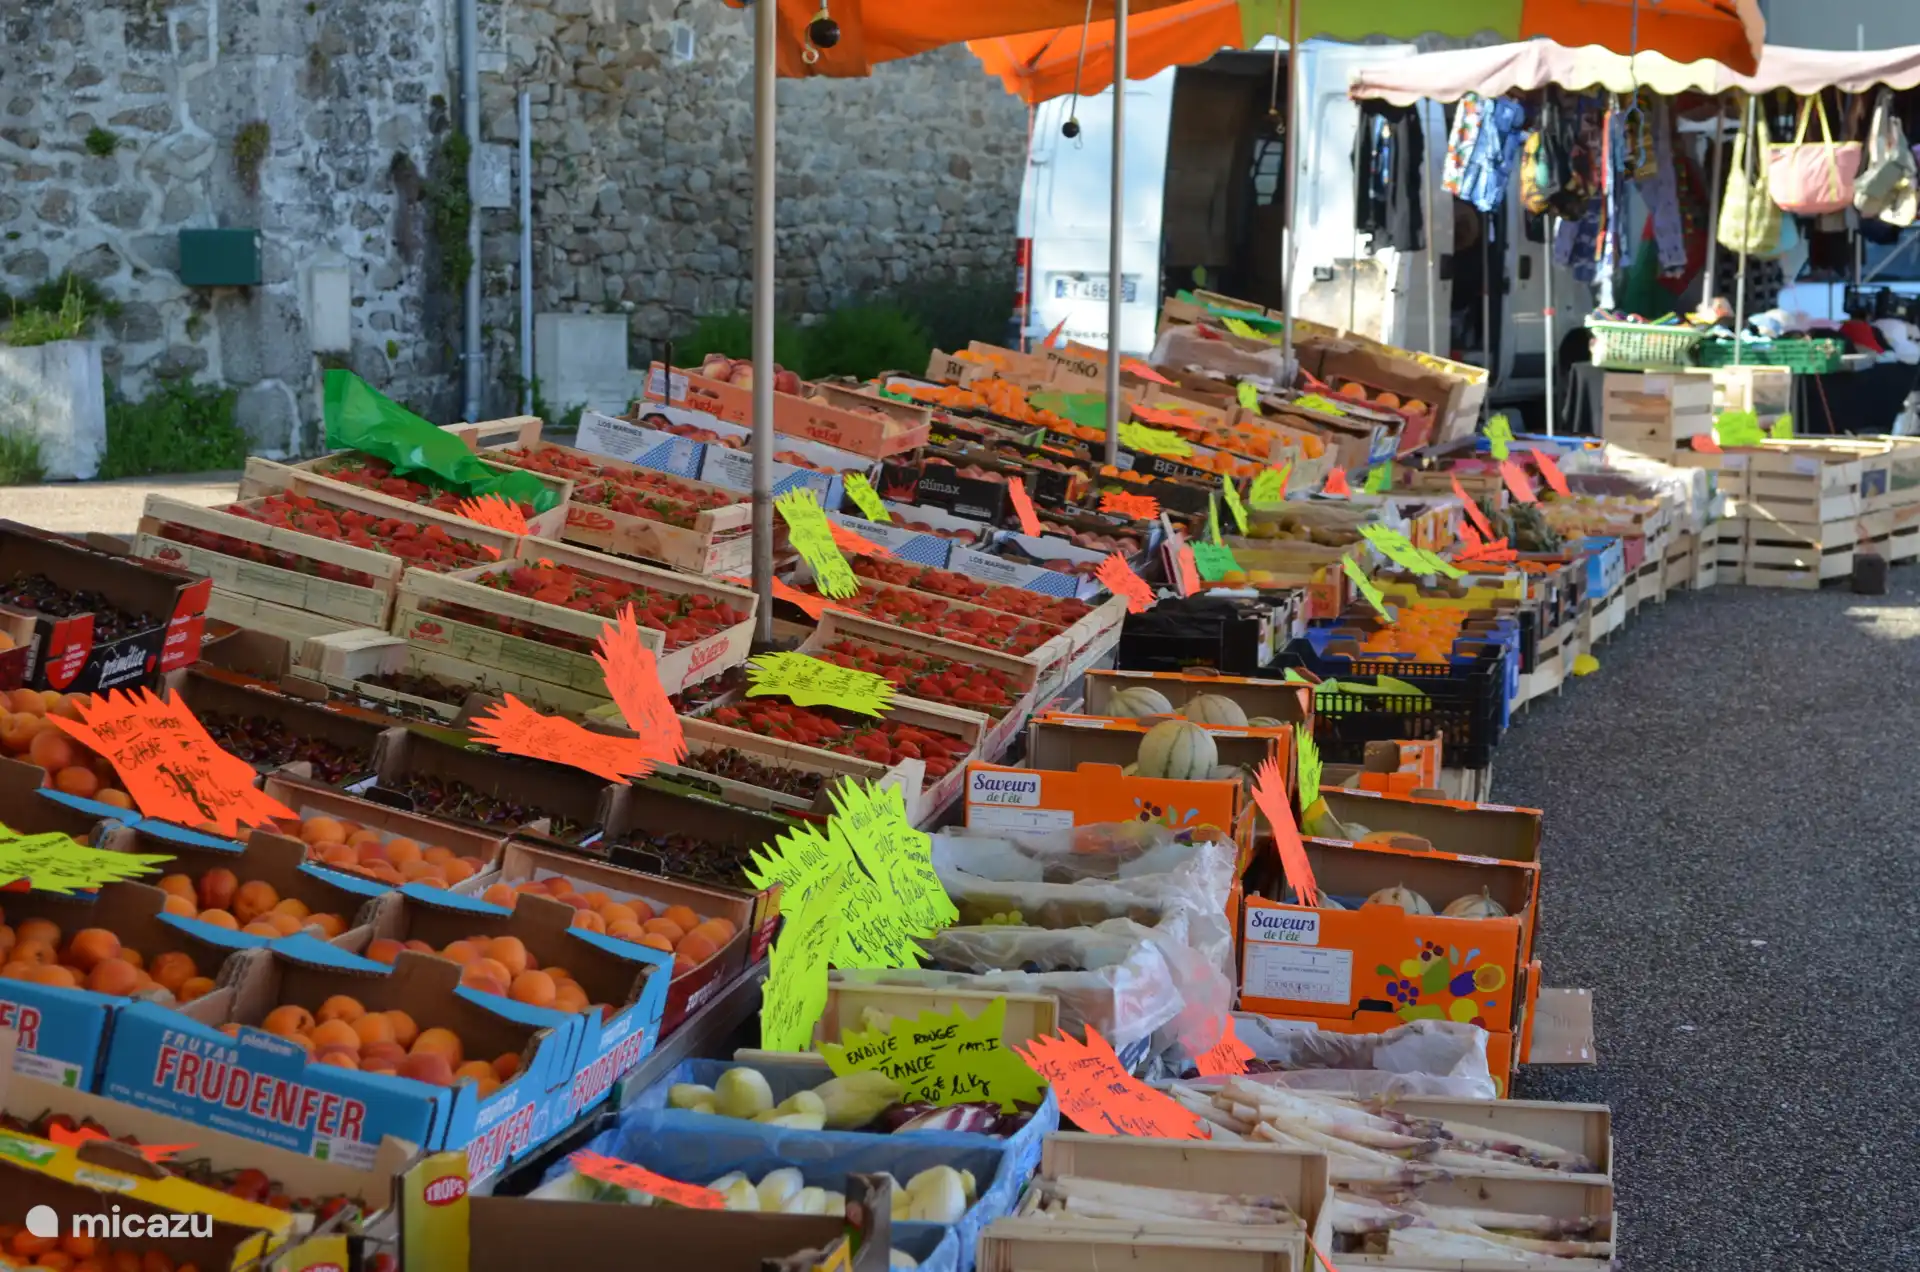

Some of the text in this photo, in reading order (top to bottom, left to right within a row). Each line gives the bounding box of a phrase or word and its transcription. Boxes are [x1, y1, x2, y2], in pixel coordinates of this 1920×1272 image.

[598, 419, 643, 437] LOS MARINES
[724, 452, 738, 461] LOS
[842, 519, 888, 536] LOS MARINES
[969, 555, 1016, 572] LOS MARINES
[974, 773, 1037, 793] Saveurs
[986, 792, 1000, 803] de
[800, 841, 829, 869] NOIR
[1251, 910, 1316, 932] Saveurs
[1263, 930, 1276, 940] de
[162, 1029, 240, 1064] FRUTAS
[846, 1037, 898, 1065] ENDIVE
[913, 1024, 960, 1045] ROUGE
[567, 1027, 645, 1118] FRUDENFER
[869, 1054, 936, 1083] RANCE
[153, 1043, 367, 1143] FRUDENFER
[425, 1178, 467, 1201] TROPS
